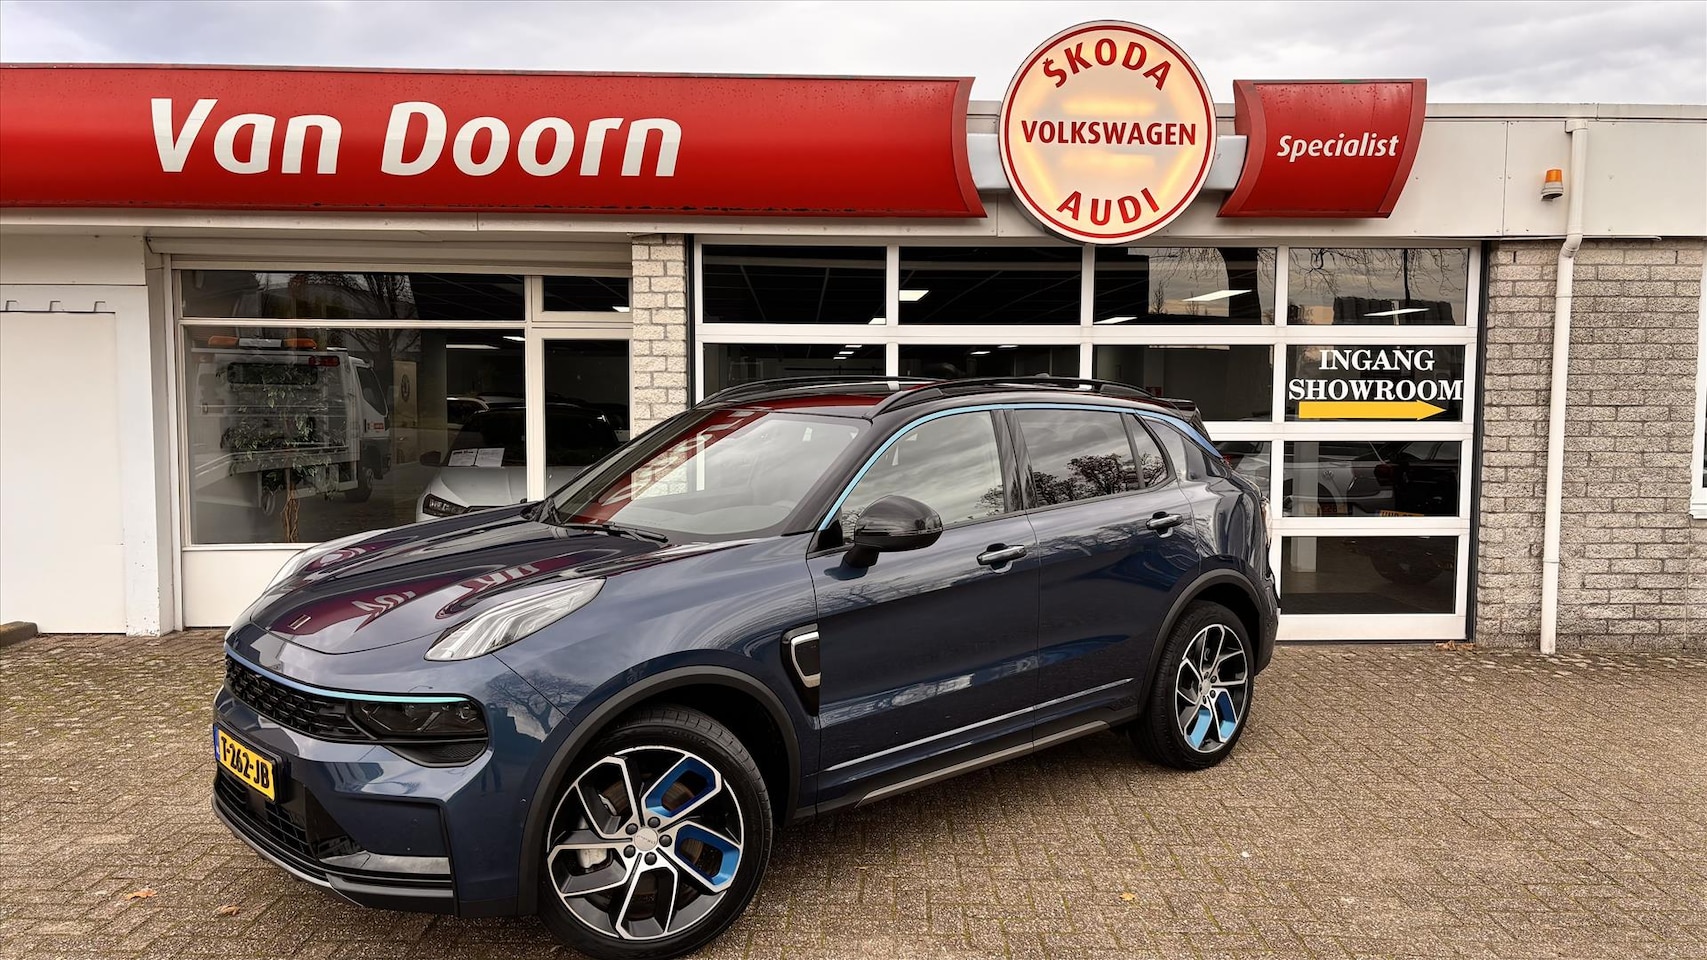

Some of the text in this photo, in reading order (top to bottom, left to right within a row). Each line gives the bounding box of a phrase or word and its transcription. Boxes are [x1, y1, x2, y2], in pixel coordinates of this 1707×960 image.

[1042, 37, 1173, 91] ŠKODA
[150, 97, 682, 177] Van Doorn
[1021, 120, 1197, 146] VOLKSWAGEN
[1276, 132, 1400, 163] Specialist
[1056, 187, 1160, 226] AUDI
[1318, 349, 1436, 371] INGANG
[1288, 378, 1464, 402] SHOWROOM
[220, 736, 271, 789] T-262-JB
